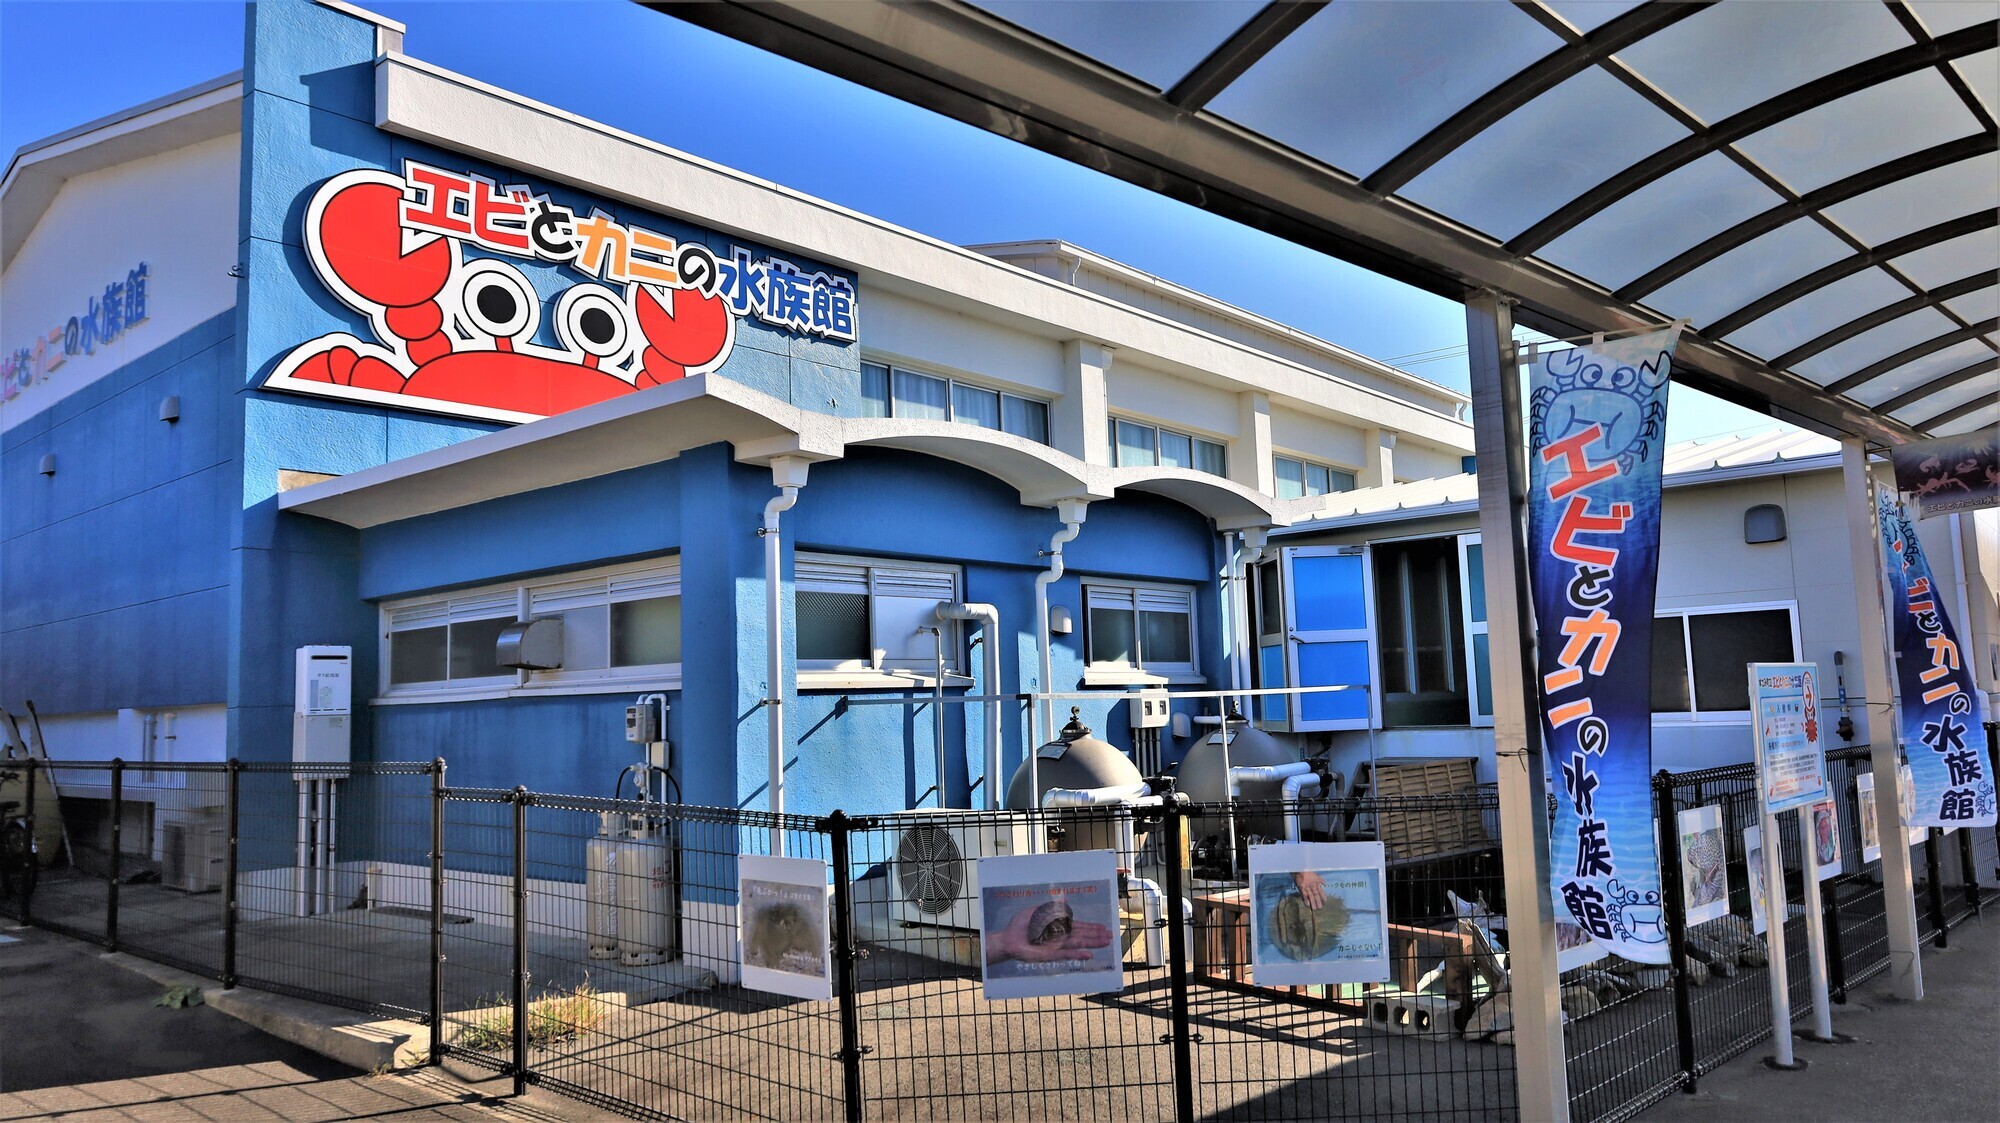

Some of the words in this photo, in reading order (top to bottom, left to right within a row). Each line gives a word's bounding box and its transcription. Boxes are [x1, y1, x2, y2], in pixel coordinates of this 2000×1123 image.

[405, 166, 851, 335] エビとカニの水族館
[1541, 424, 1632, 941] エビとカニの水族館
